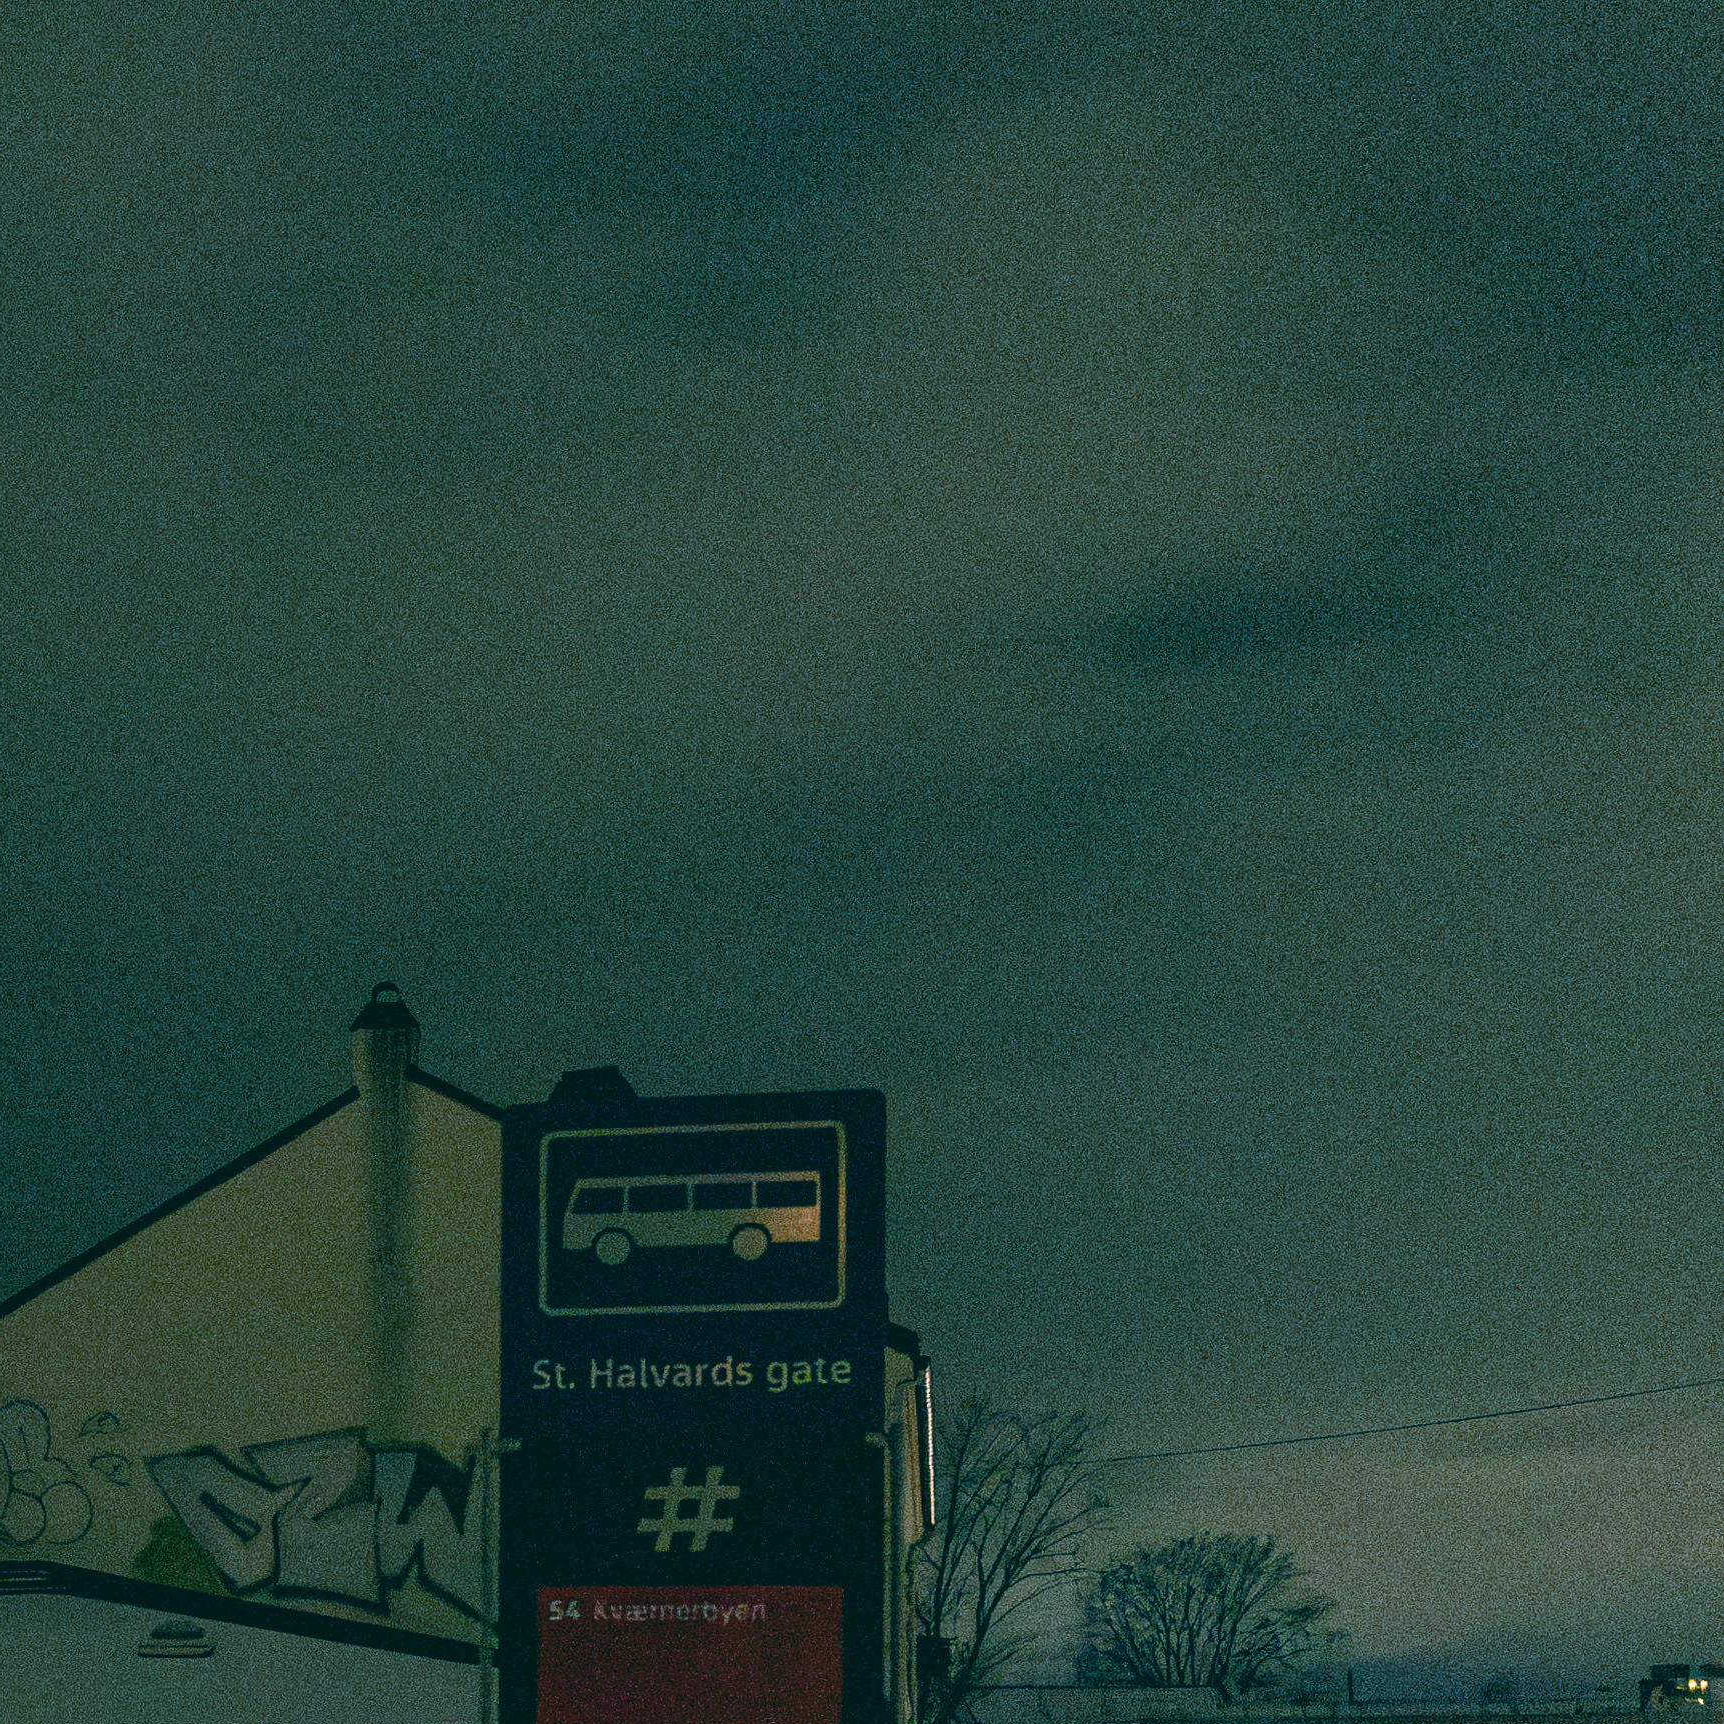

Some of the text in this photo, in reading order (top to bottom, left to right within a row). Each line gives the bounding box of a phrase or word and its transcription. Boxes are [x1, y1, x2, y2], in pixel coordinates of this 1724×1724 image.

[531, 1355, 853, 1393] St. Halvards gate
[547, 1599, 582, 1622] 54
